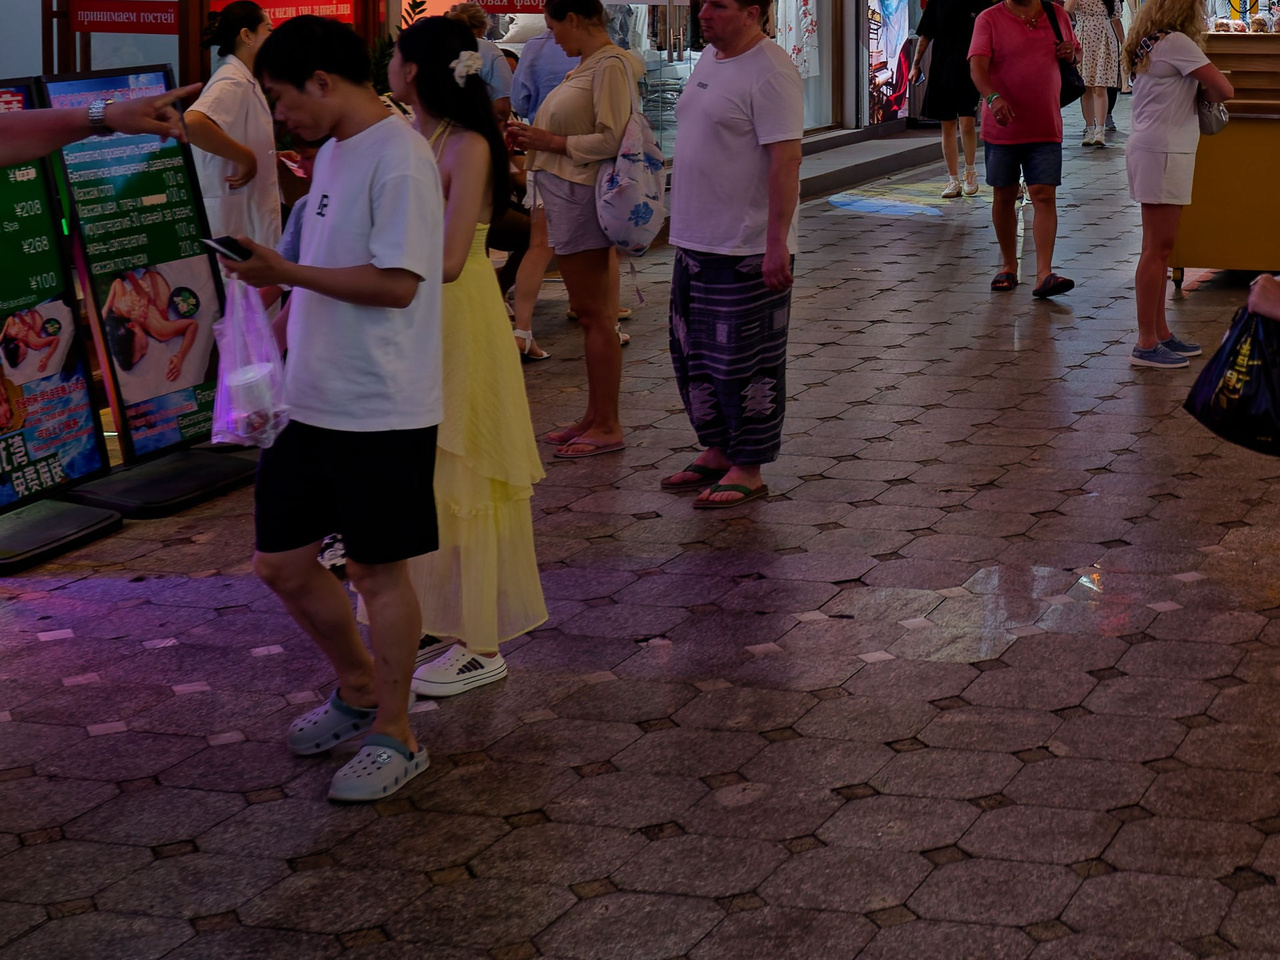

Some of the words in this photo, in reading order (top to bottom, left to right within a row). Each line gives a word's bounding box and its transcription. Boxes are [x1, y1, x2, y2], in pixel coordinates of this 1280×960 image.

[77, 10, 137, 25] принимаем
[140, 9, 175, 24] гостей
[14, 199, 42, 218] ¥208
[3, 221, 20, 234] Spa
[21, 235, 50, 255] ¥268
[29, 271, 57, 291] ¥100
[11, 453, 66, 499] 免费接送
